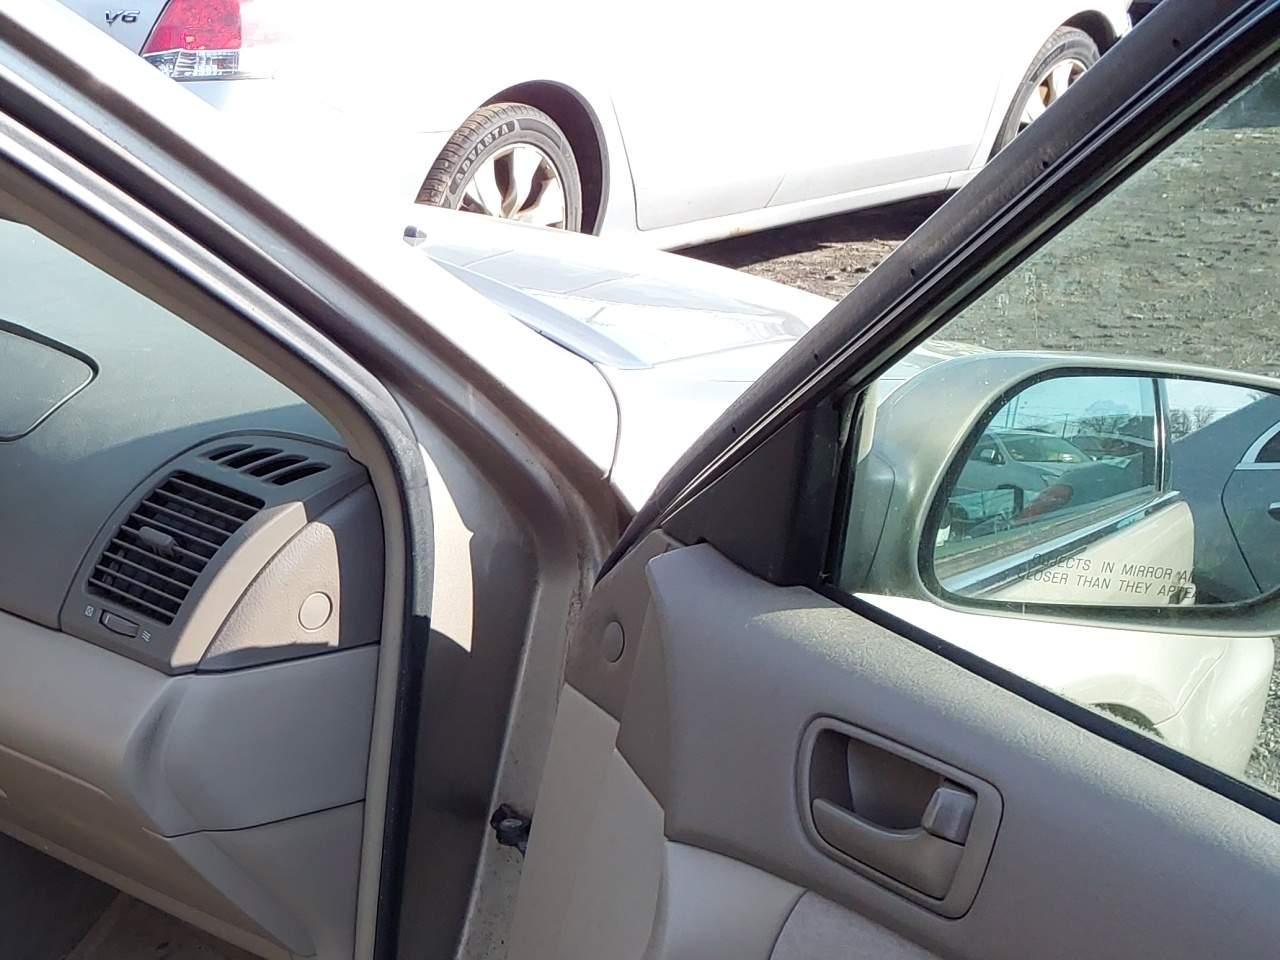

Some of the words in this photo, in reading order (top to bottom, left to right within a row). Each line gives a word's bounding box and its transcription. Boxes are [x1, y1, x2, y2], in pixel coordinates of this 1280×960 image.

[105, 10, 140, 24] V6
[455, 124, 509, 183] ADVANTA
[1101, 561, 1115, 573] IN
[1121, 563, 1173, 580] MIRROR
[1076, 574, 1111, 589] THAN
[1120, 579, 1152, 594] THEY
